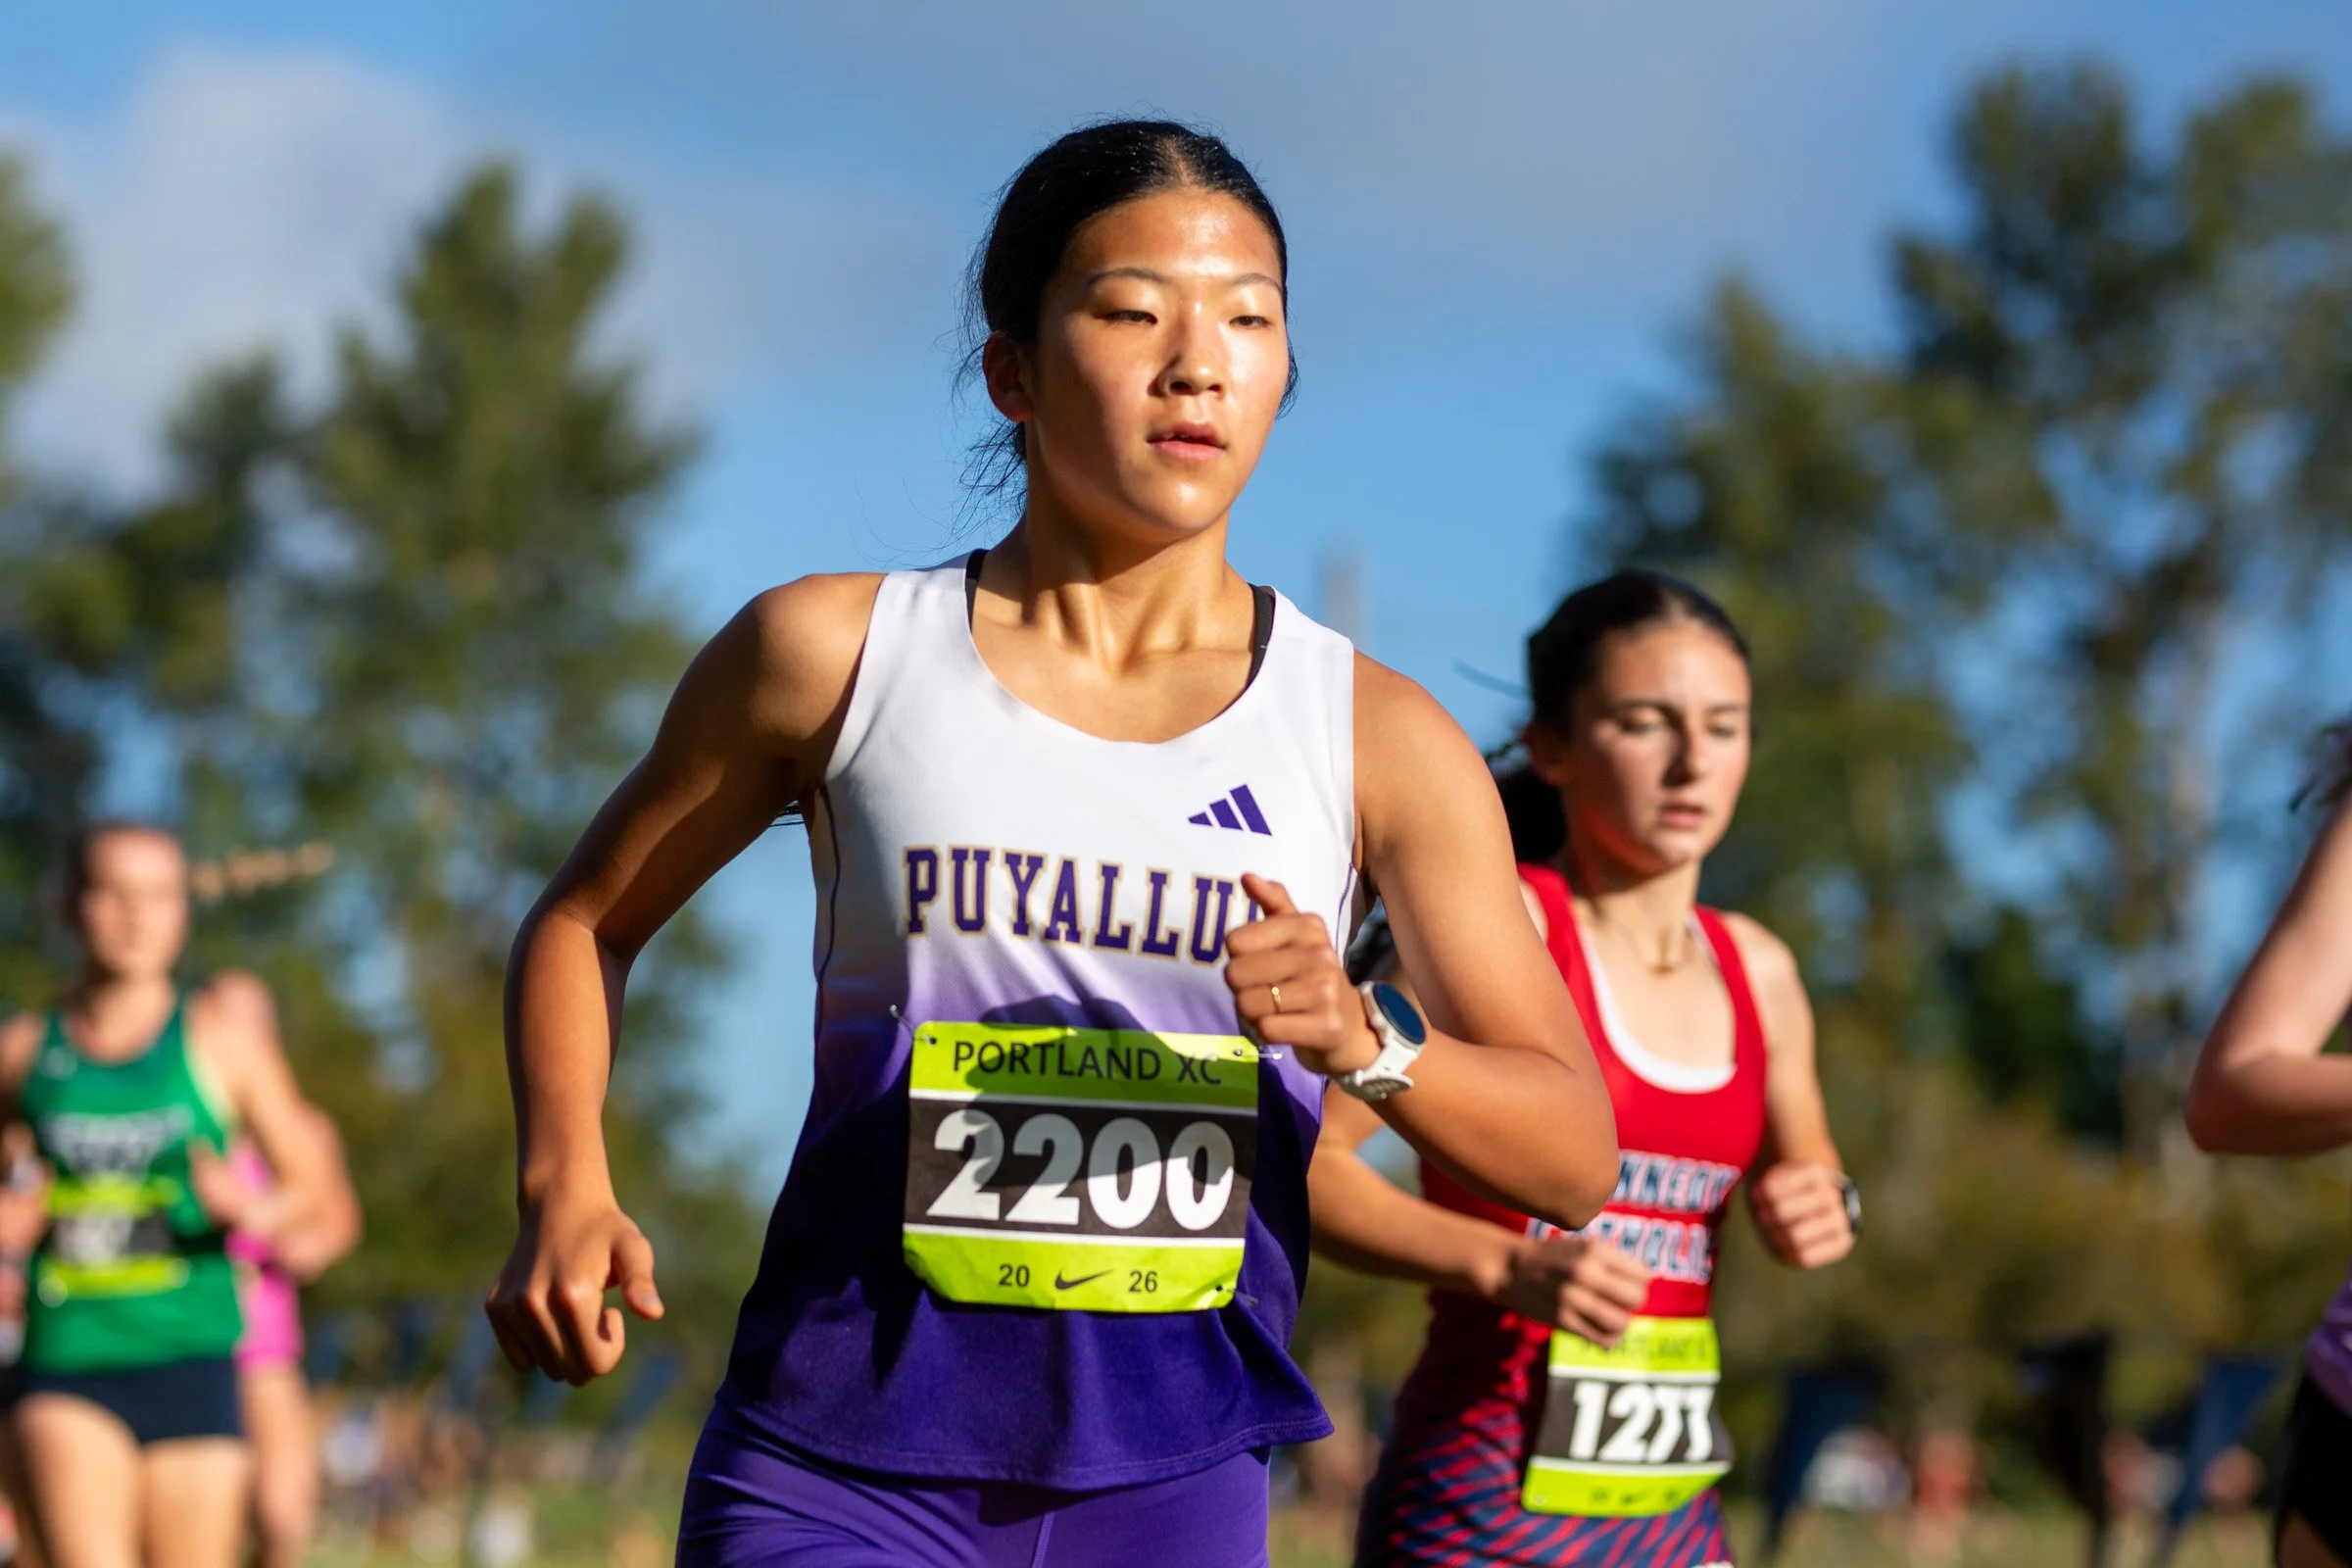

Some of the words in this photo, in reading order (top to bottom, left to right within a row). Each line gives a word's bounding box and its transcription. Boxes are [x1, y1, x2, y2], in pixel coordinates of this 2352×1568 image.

[904, 844, 1264, 967] PUYALLU
[953, 1041, 1162, 1081] PORTLAND
[1176, 1052, 1223, 1086] XC
[926, 1108, 1235, 1231] 2200
[999, 1263, 1031, 1288] 20
[1128, 1270, 1158, 1294] 26
